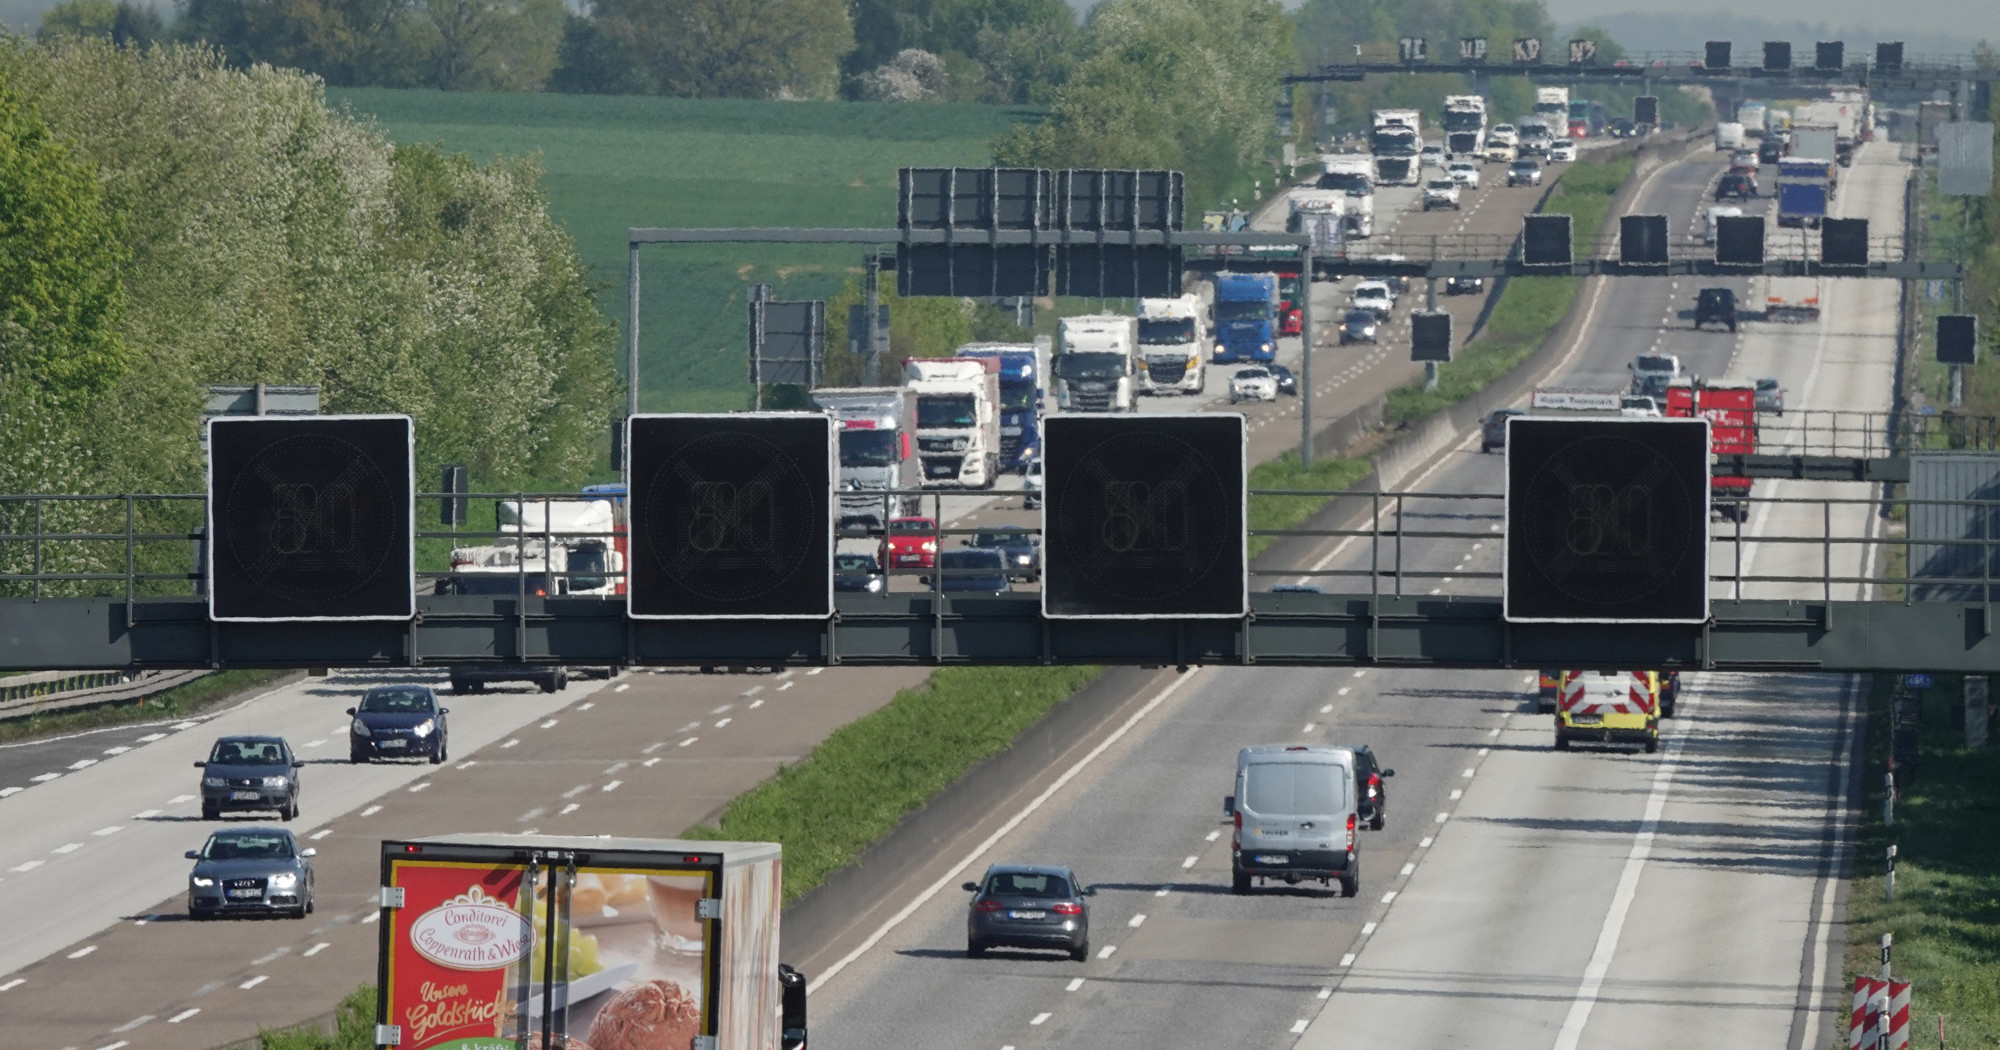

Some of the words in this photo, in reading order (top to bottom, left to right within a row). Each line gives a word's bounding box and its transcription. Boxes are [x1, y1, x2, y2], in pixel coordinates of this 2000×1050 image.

[445, 908, 508, 927] Conditorei
[419, 928, 485, 961] Coppenrath
[487, 948, 497, 961] &
[420, 981, 468, 1002] Unsere
